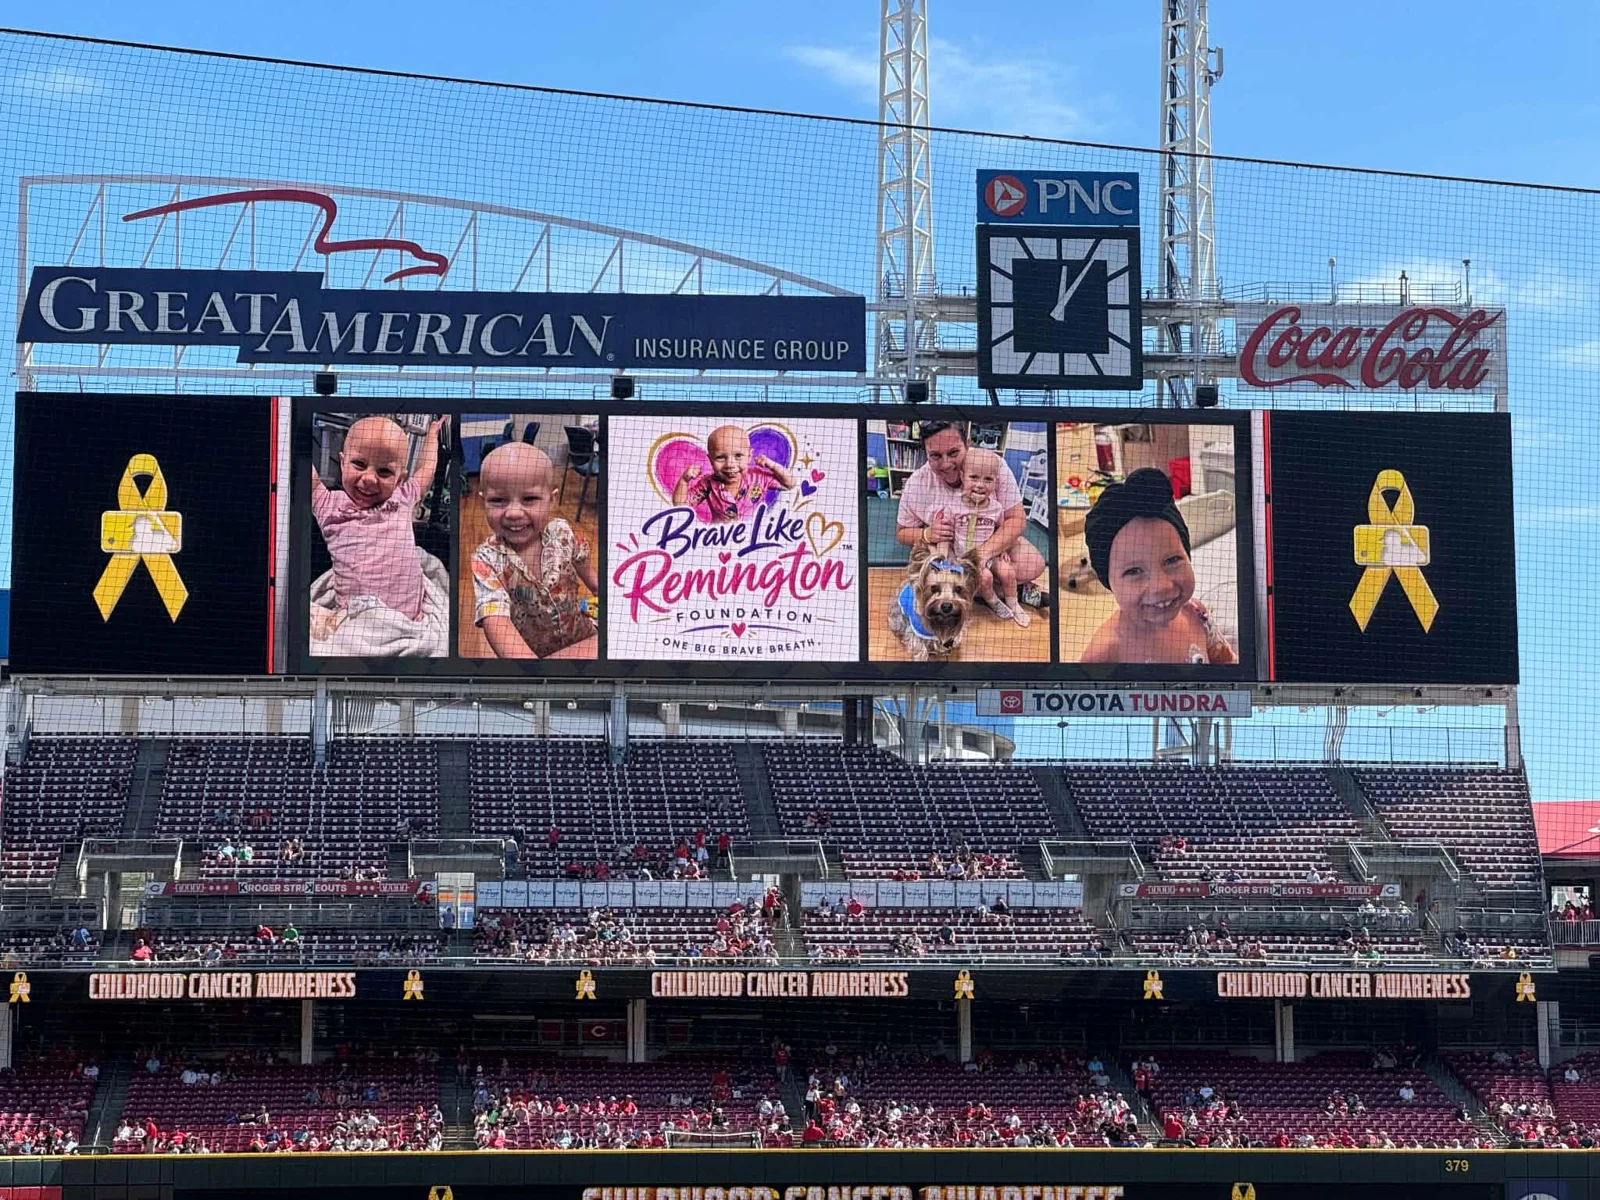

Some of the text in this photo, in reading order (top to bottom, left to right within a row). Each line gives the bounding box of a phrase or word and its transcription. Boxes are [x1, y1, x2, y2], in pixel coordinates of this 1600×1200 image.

[1034, 178, 1134, 215] PNC
[38, 275, 850, 363] GREAT AMERICAN INSURANCE GROUP
[1239, 305, 1503, 391] Coca-Cola
[641, 503, 806, 559] Brave Like
[612, 541, 855, 624] Remington
[676, 607, 814, 624] FOUNDATION
[662, 637, 815, 655] ONE BIG BRAVE BREATH
[1032, 693, 1229, 712] TOYOTA TUNDRA
[238, 881, 281, 894] KROGER
[1208, 884, 1251, 895] KROGER
[88, 972, 356, 1000] CHILDHOOD CANCER AWARENESS
[651, 971, 909, 998] CHILDHOOD CANCER AWARENESS
[1217, 972, 1471, 999] CHILDHOOD CANCER AWARENESS
[1444, 1159, 1469, 1172] 379
